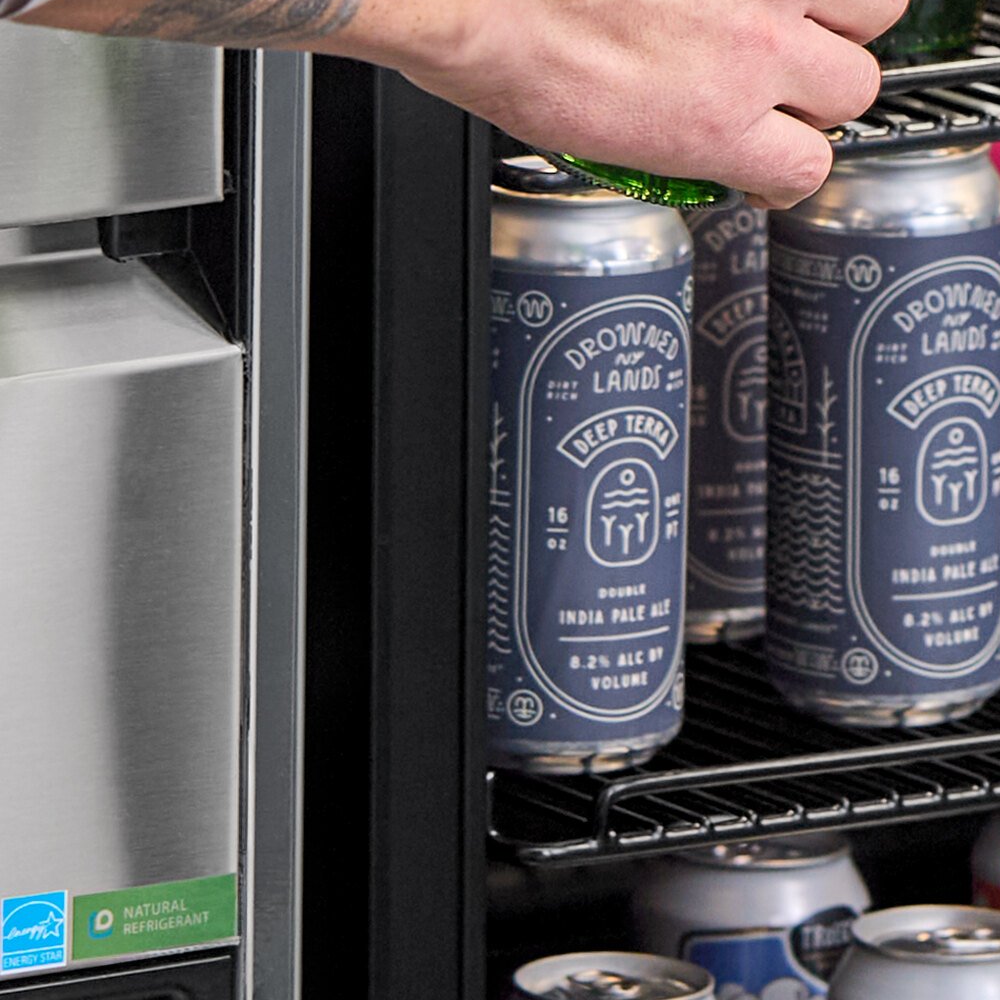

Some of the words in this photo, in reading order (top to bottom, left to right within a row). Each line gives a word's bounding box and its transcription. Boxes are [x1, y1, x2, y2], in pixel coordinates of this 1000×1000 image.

[565, 321, 680, 371] DROWNED
[921, 323, 988, 356] LANDS
[593, 364, 662, 394] LANDS
[903, 378, 947, 416] DEEP
[573, 418, 618, 455] DEEP
[626, 414, 670, 447] TERRA
[878, 466, 900, 485] 16
[547, 506, 568, 524] 16
[892, 567, 937, 584] INDIA
[942, 561, 975, 582] PALE
[598, 583, 646, 600] DOUBLE
[559, 609, 604, 626] INDIA
[611, 603, 645, 624] PALE
[651, 597, 671, 618] ALE
[924, 626, 979, 648] VOLUME
[569, 653, 611, 670] 8.2%
[617, 651, 645, 668] ALC
[648, 647, 664, 663] BY
[591, 671, 648, 691] VOLUME
[123, 899, 187, 919] NATURAL
[123, 911, 209, 935] REFRIGERANT
[3, 953, 38, 969] ENERGY
[40, 949, 63, 963] STAR
